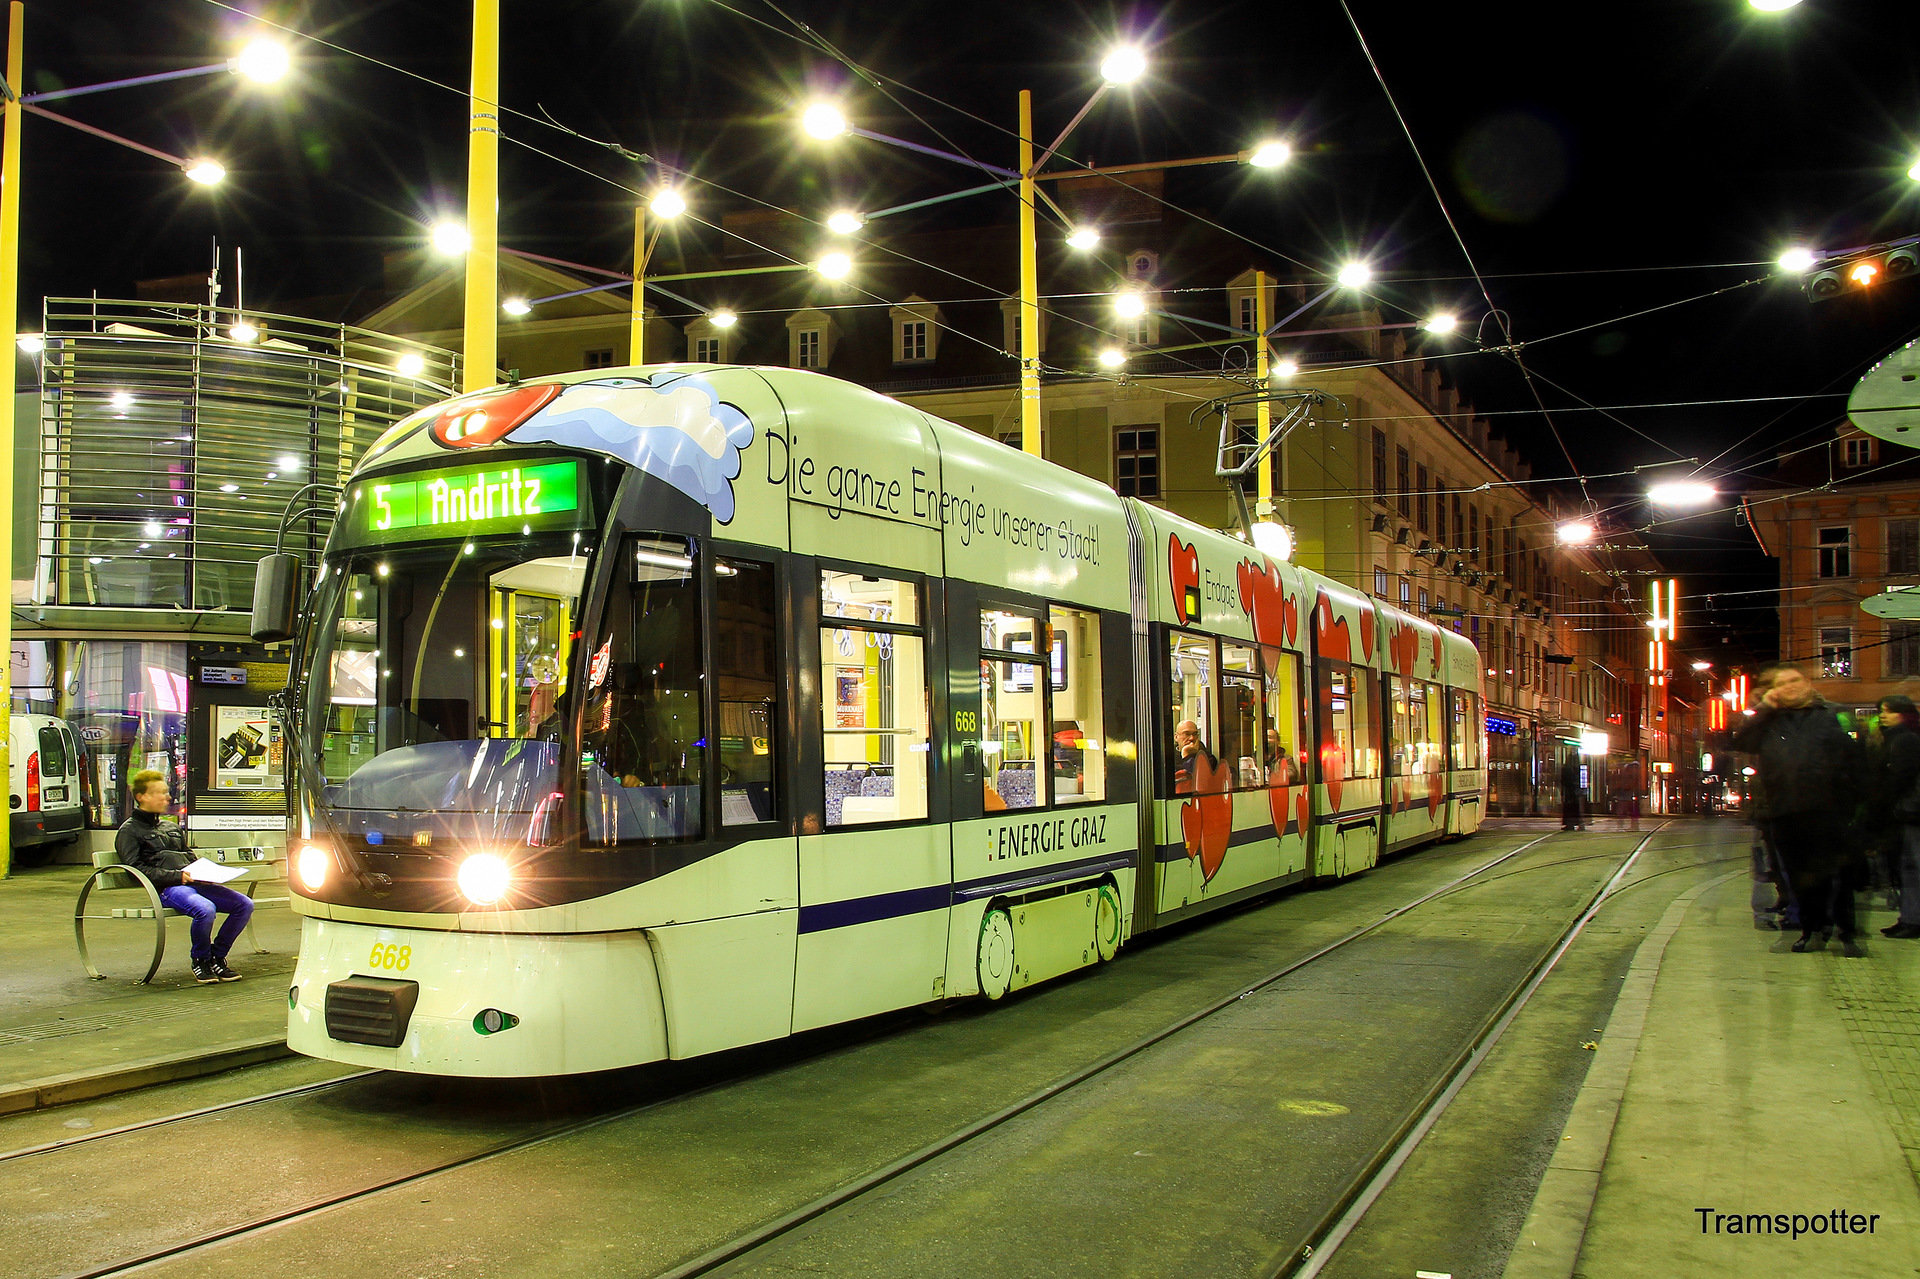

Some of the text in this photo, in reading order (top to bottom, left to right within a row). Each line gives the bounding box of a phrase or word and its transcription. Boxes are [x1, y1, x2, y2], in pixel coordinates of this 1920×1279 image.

[374, 468, 541, 530] 5 Andritz
[766, 428, 1100, 567] Die ganze Energie unserer Stadt!
[1205, 567, 1235, 617] Erdgas
[955, 710, 976, 732] 668
[998, 815, 1107, 860] ENERGIE GRAZ
[369, 942, 412, 971] 668
